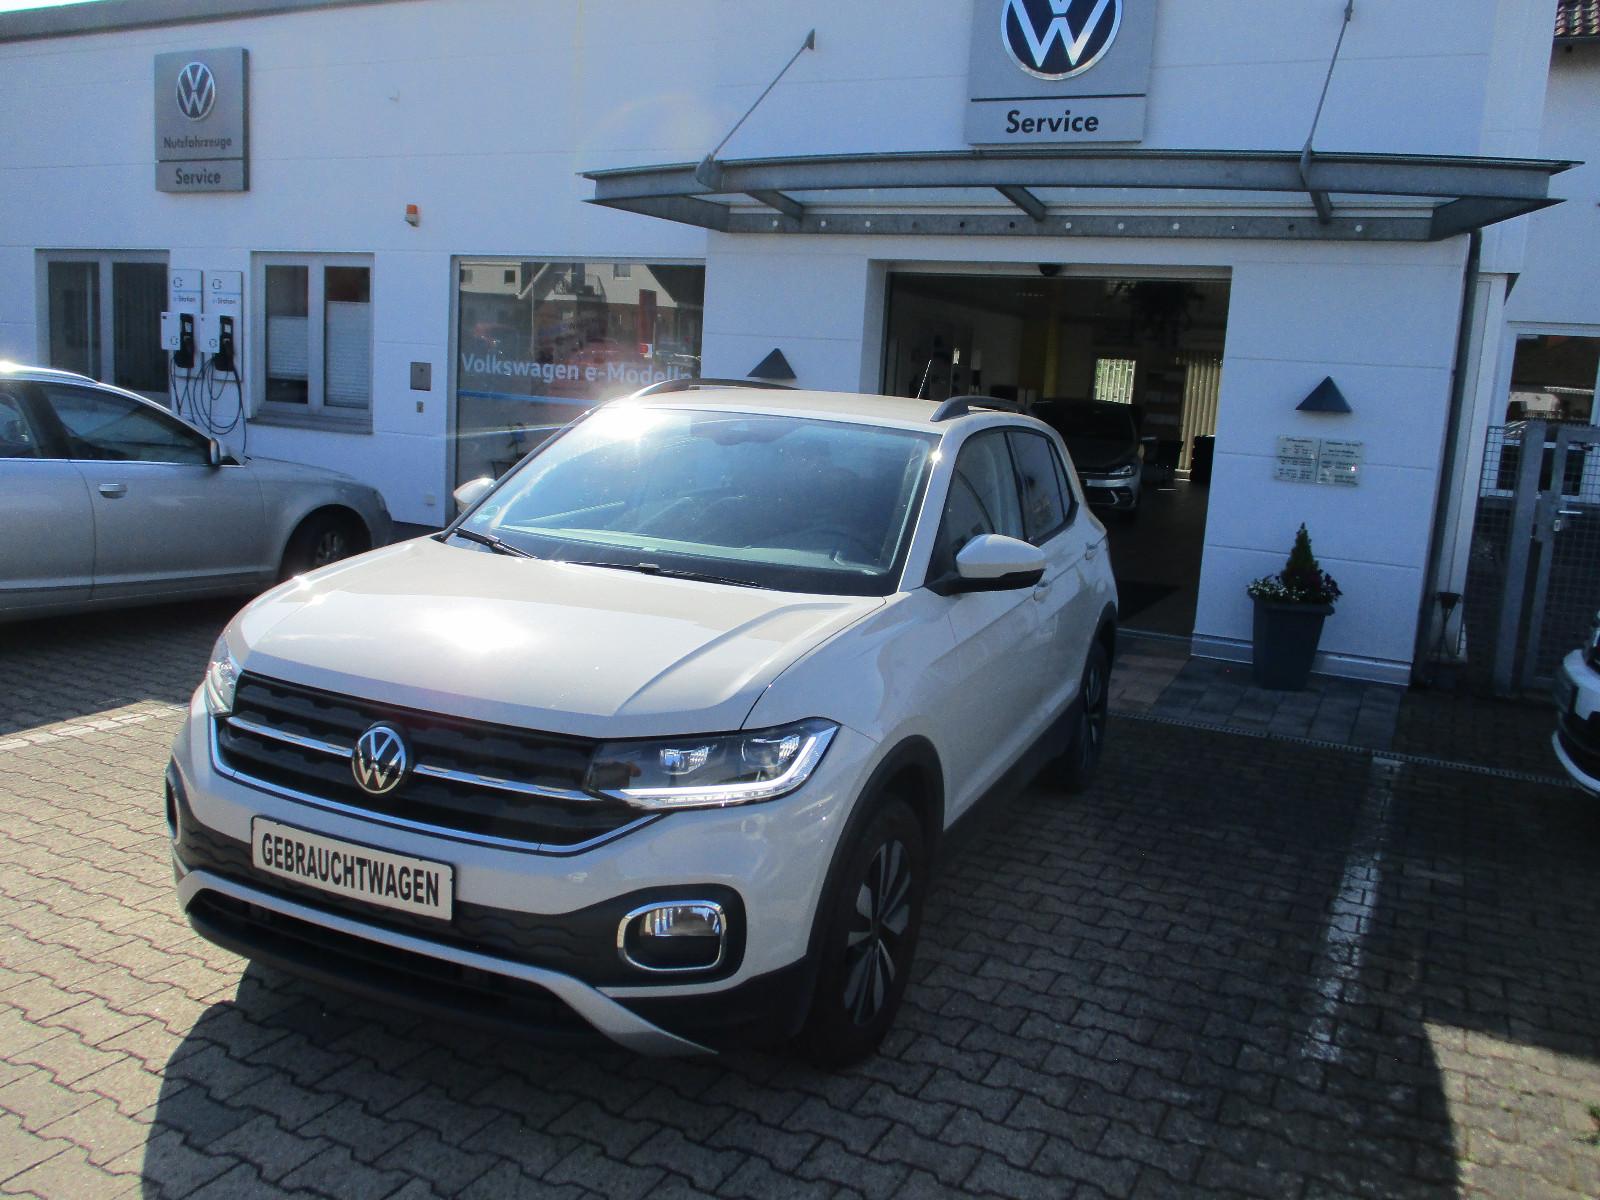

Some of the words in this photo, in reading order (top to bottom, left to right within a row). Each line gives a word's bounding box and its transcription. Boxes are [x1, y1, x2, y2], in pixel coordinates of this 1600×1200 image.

[1005, 109, 1099, 134] Service
[163, 135, 232, 149] Nutzfahrzeuge
[175, 168, 221, 185] Service
[462, 353, 579, 384] Volkswagen
[261, 832, 439, 907] GEBRAUCHTWAGEN
